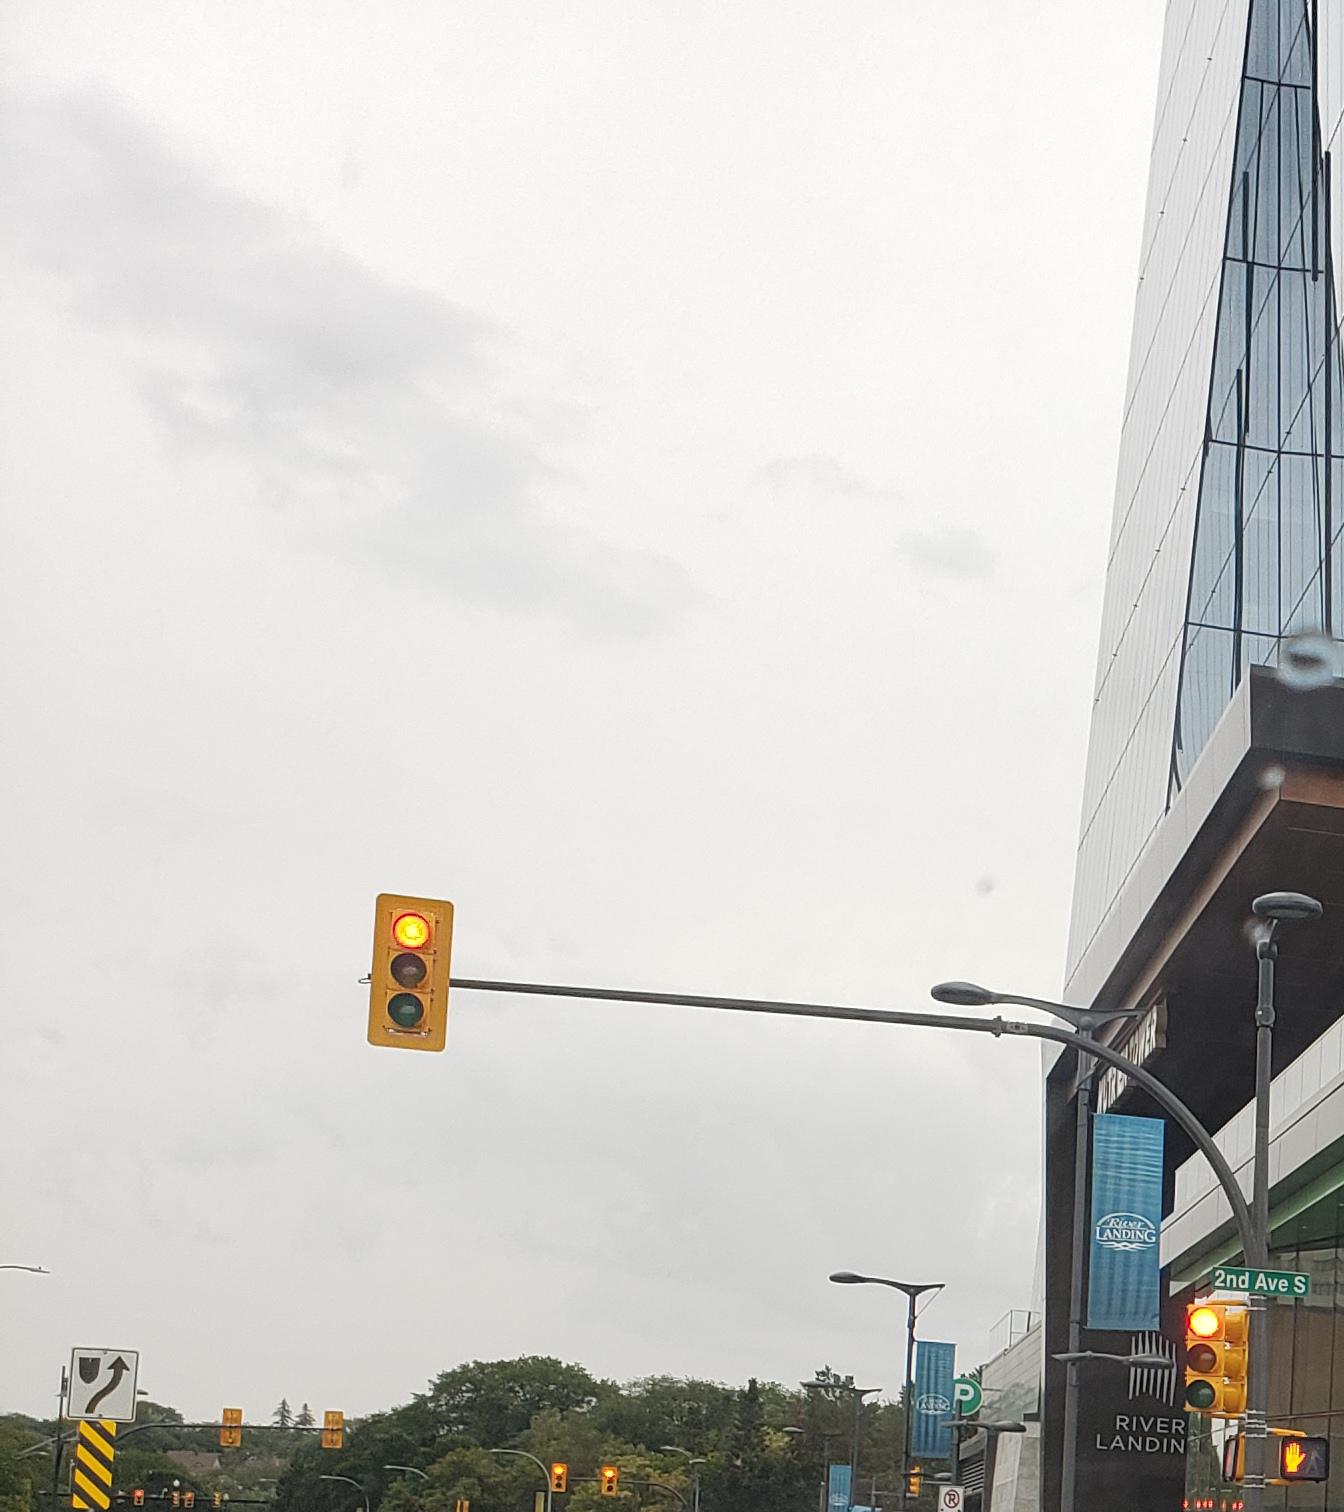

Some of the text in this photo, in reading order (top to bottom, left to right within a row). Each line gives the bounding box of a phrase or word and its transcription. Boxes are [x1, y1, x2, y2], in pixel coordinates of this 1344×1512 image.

[1107, 1217, 1145, 1229] River
[1095, 1226, 1157, 1243] LANDING
[1214, 1269, 1306, 1294] 2nd Ave S
[953, 1383, 975, 1409] P
[1116, 1414, 1186, 1435] RIVER
[1095, 1433, 1186, 1455] LANDIN
